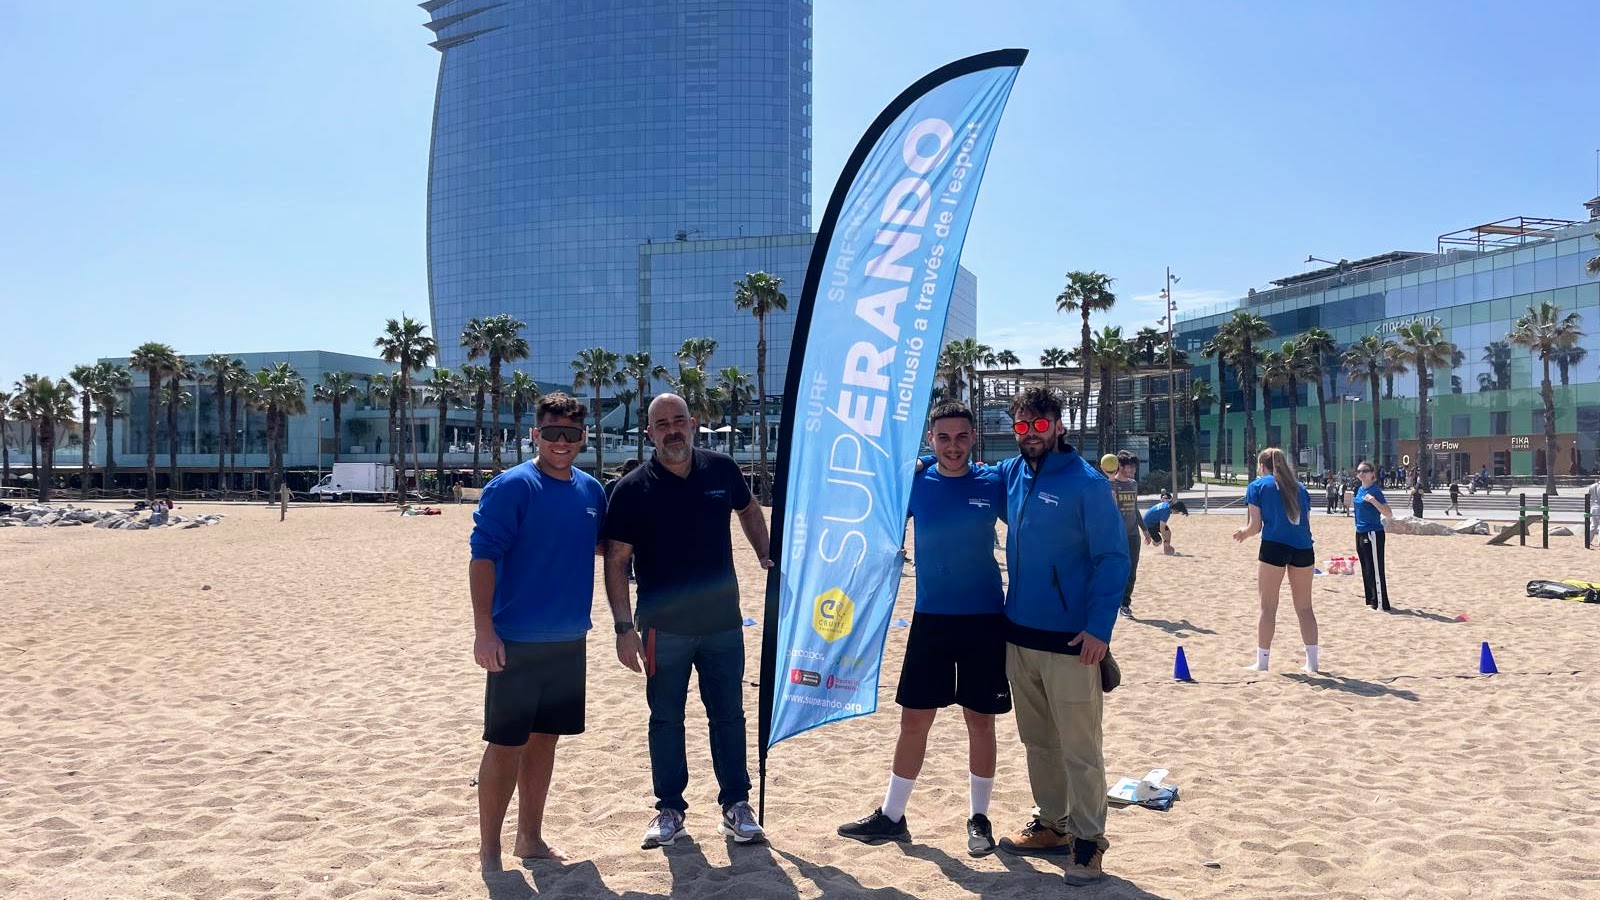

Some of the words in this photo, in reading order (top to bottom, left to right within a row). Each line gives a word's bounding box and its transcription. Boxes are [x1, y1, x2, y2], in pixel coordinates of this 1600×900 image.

[940, 121, 981, 205] l'esport
[933, 211, 953, 238] de
[914, 244, 945, 312] través
[914, 319, 929, 332] a
[805, 371, 829, 433] SURF
[892, 336, 924, 422] Inclusió
[1441, 441, 1459, 450] Flow
[1511, 437, 1529, 445] FIKA
[791, 512, 808, 560] SUP
